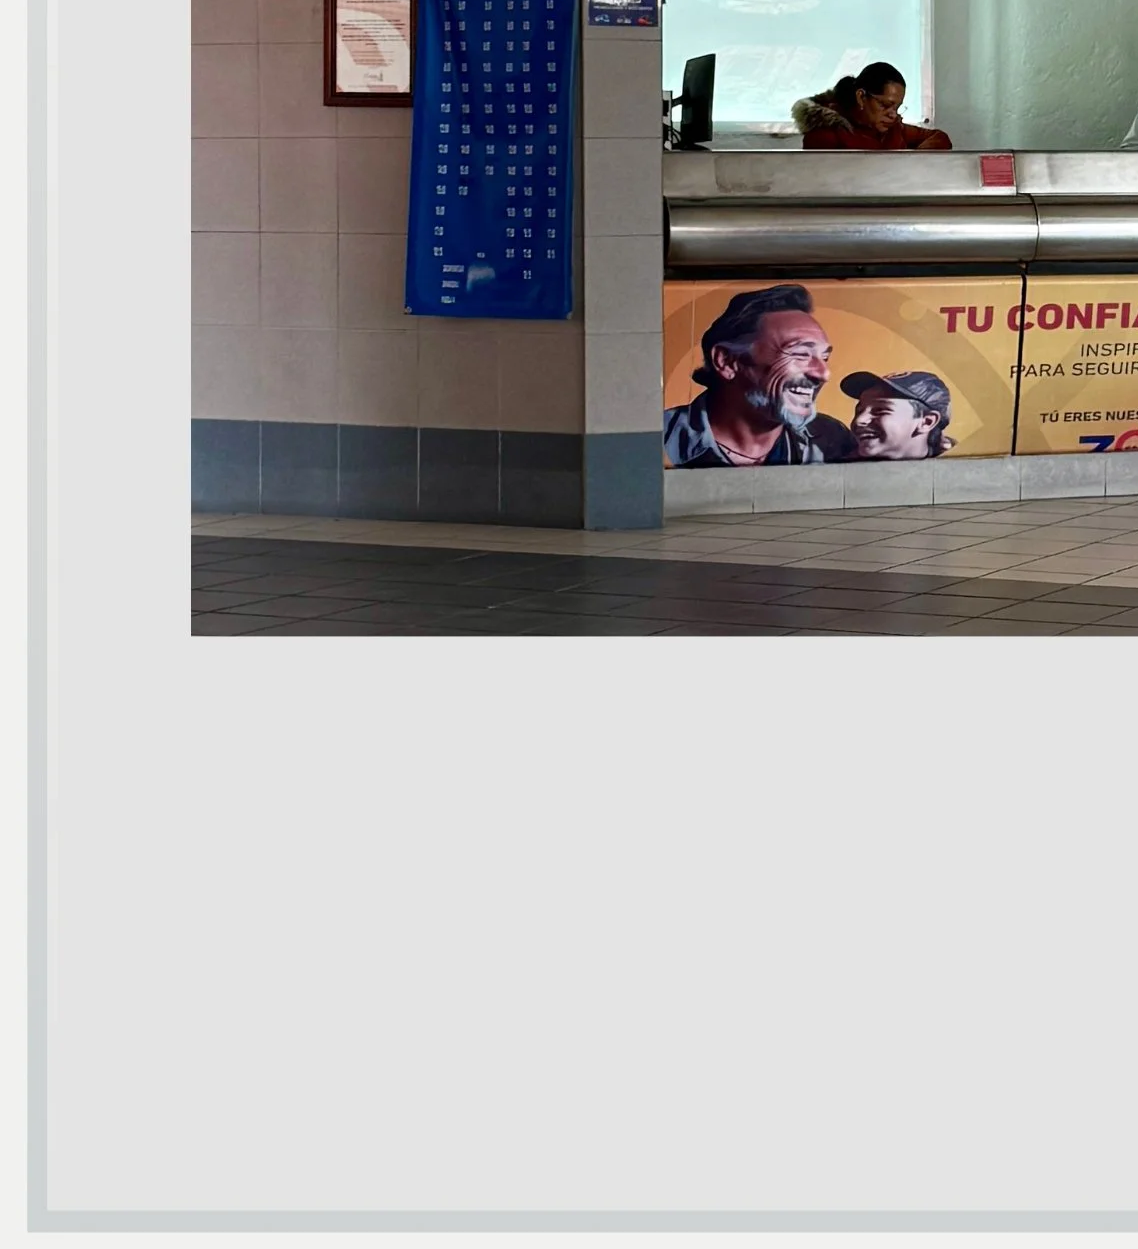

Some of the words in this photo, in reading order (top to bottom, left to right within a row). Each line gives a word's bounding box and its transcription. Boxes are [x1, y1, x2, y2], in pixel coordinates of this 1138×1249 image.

[939, 305, 994, 333] TU
[1010, 362, 1065, 379] PARA
[1040, 409, 1059, 423] TÚ
[1063, 411, 1102, 422] ERES
